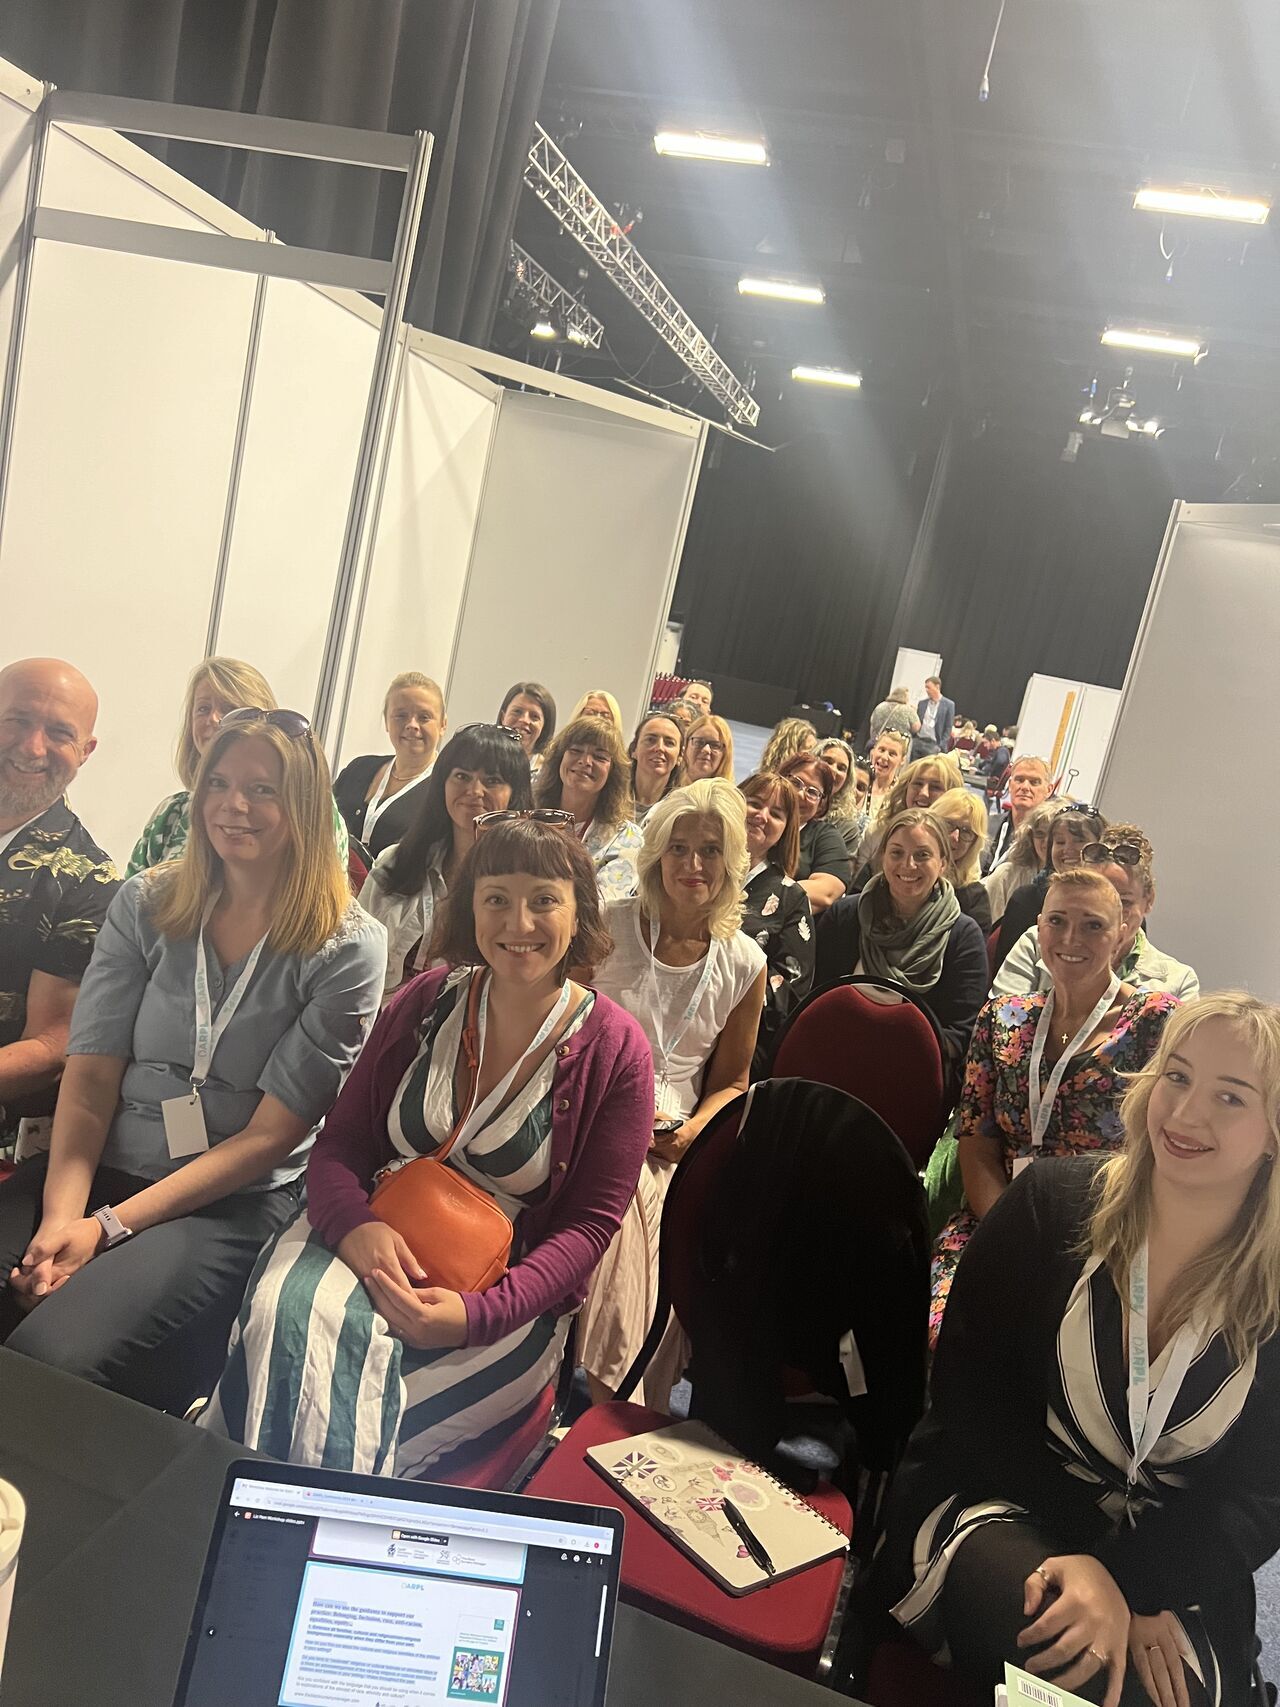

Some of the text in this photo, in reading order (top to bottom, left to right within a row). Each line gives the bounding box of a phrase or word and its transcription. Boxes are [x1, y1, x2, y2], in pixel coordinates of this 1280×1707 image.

[684, 995, 700, 1020] DARPL
[198, 1019, 209, 1057] DARPL
[1132, 1336, 1146, 1385] DARPL
